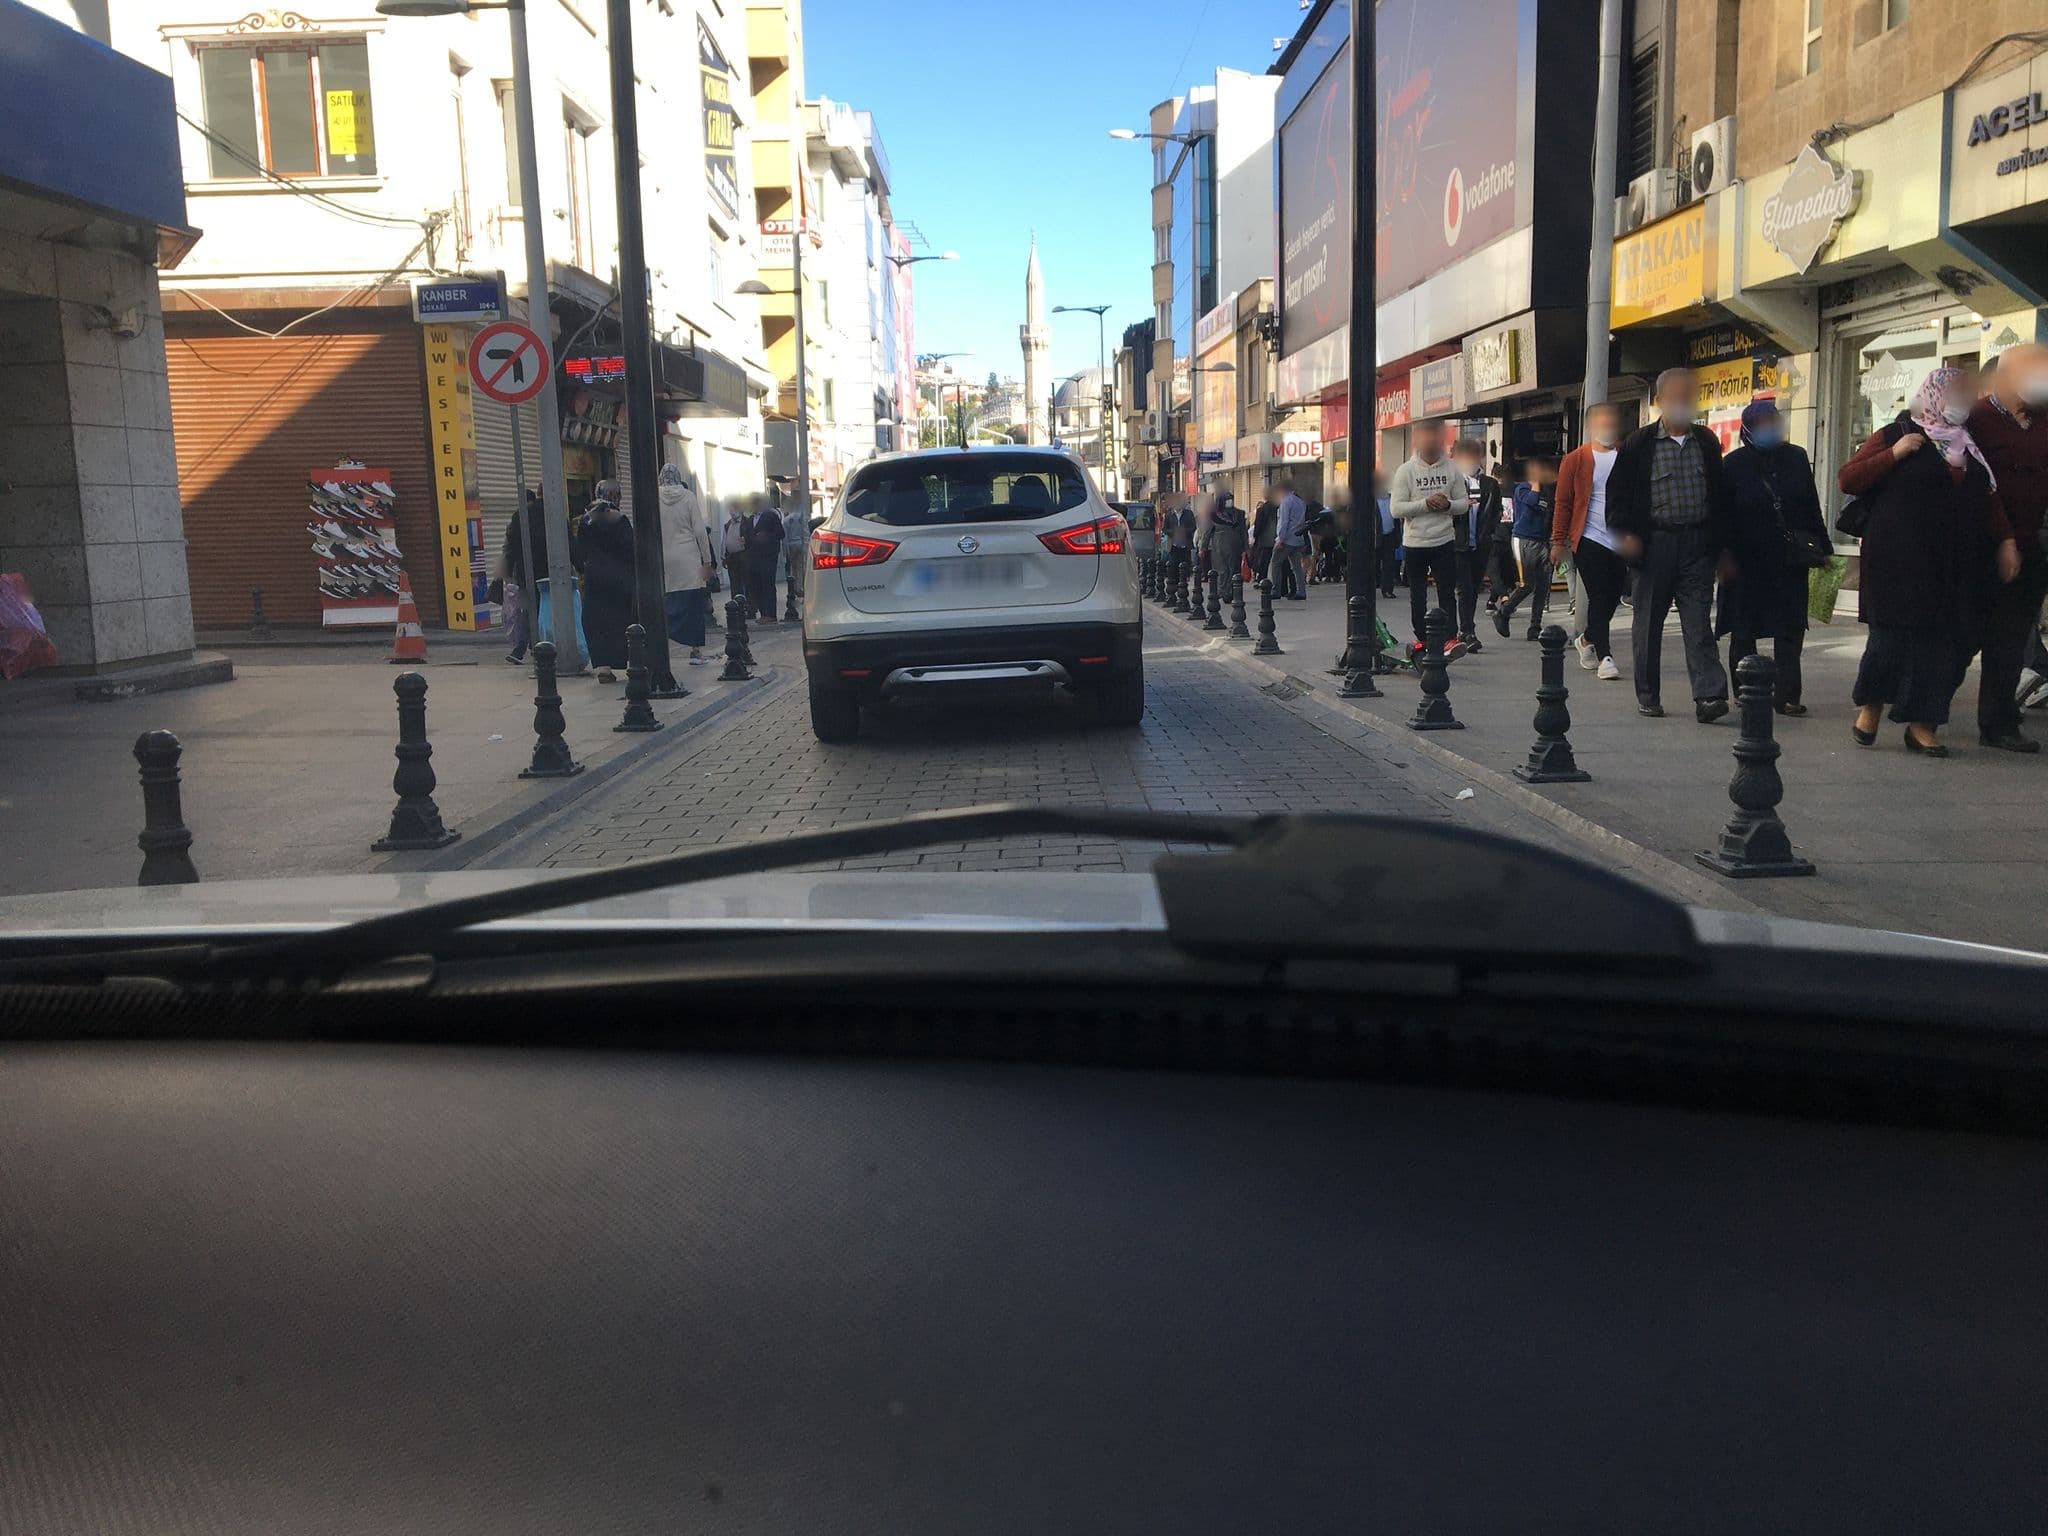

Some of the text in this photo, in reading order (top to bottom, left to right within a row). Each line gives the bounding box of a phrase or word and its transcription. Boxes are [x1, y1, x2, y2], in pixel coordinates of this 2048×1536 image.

[1465, 160, 1515, 213] vodafone
[1763, 182, 1848, 240] Hanedan
[1617, 218, 1701, 284] ATAKAN
[422, 289, 467, 302] KANBER
[431, 331, 448, 344] WU
[1719, 372, 1750, 398] GÖTÜR
[431, 353, 457, 500] WESTERN
